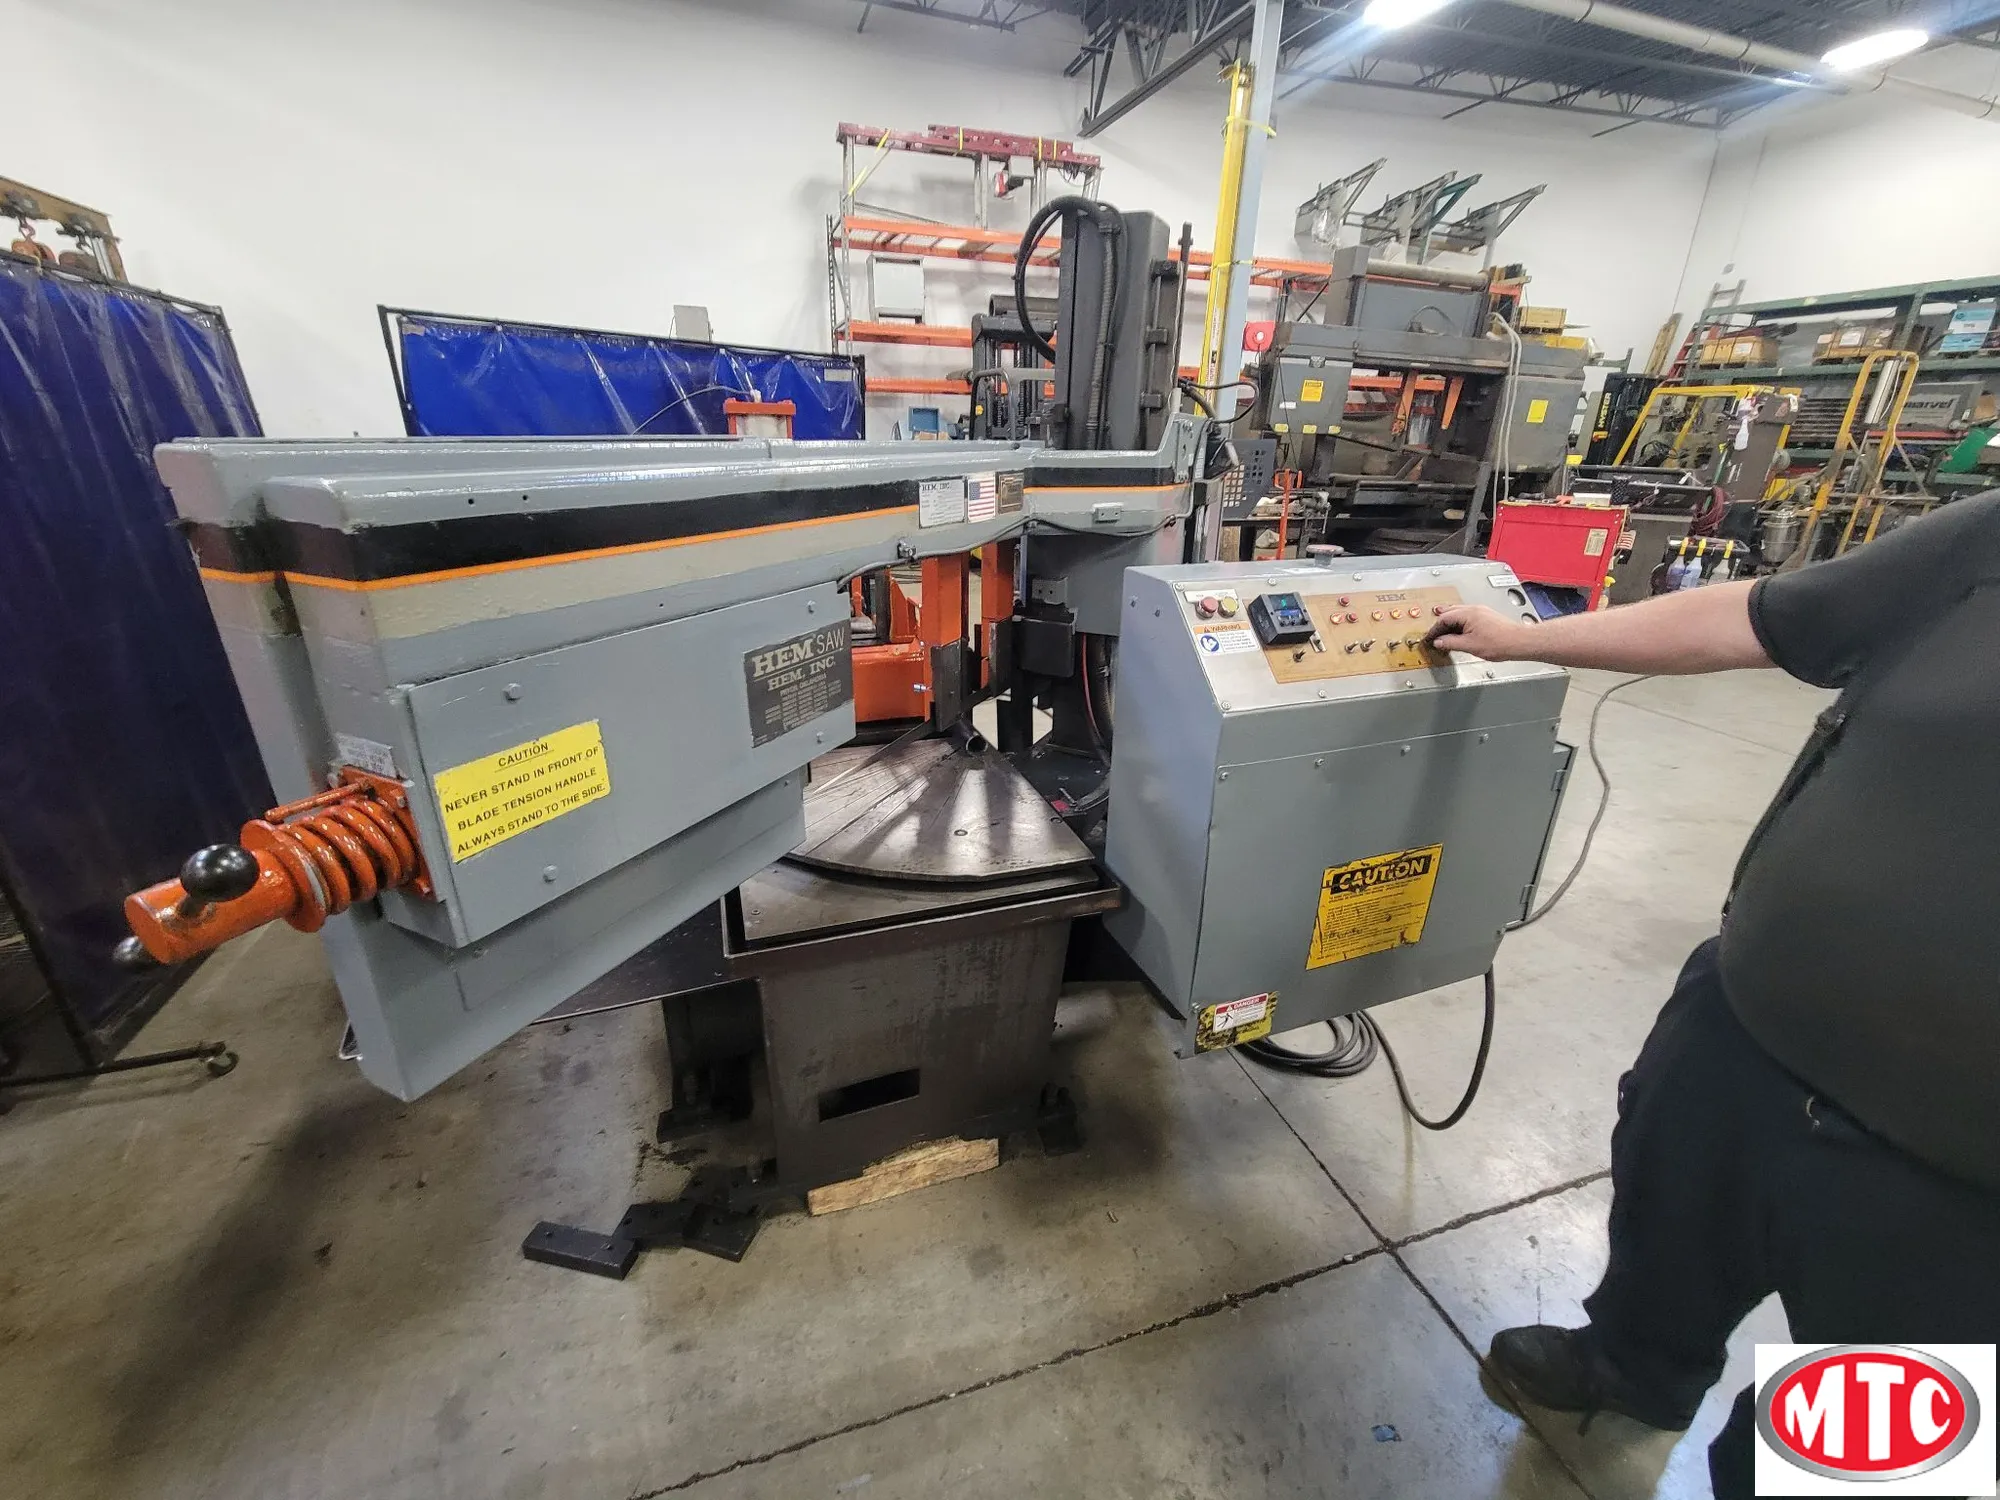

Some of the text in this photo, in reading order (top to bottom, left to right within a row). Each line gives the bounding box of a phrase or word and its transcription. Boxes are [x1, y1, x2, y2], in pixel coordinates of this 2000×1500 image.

[816, 627, 845, 654] SAW
[445, 746, 600, 813] NEVER STAND IN FRONT OF
[498, 742, 549, 767] CAUTION
[457, 767, 597, 831] BLADE TENSION HANDLE
[457, 783, 606, 853] ALWAYS STAND TO THE SIDE.
